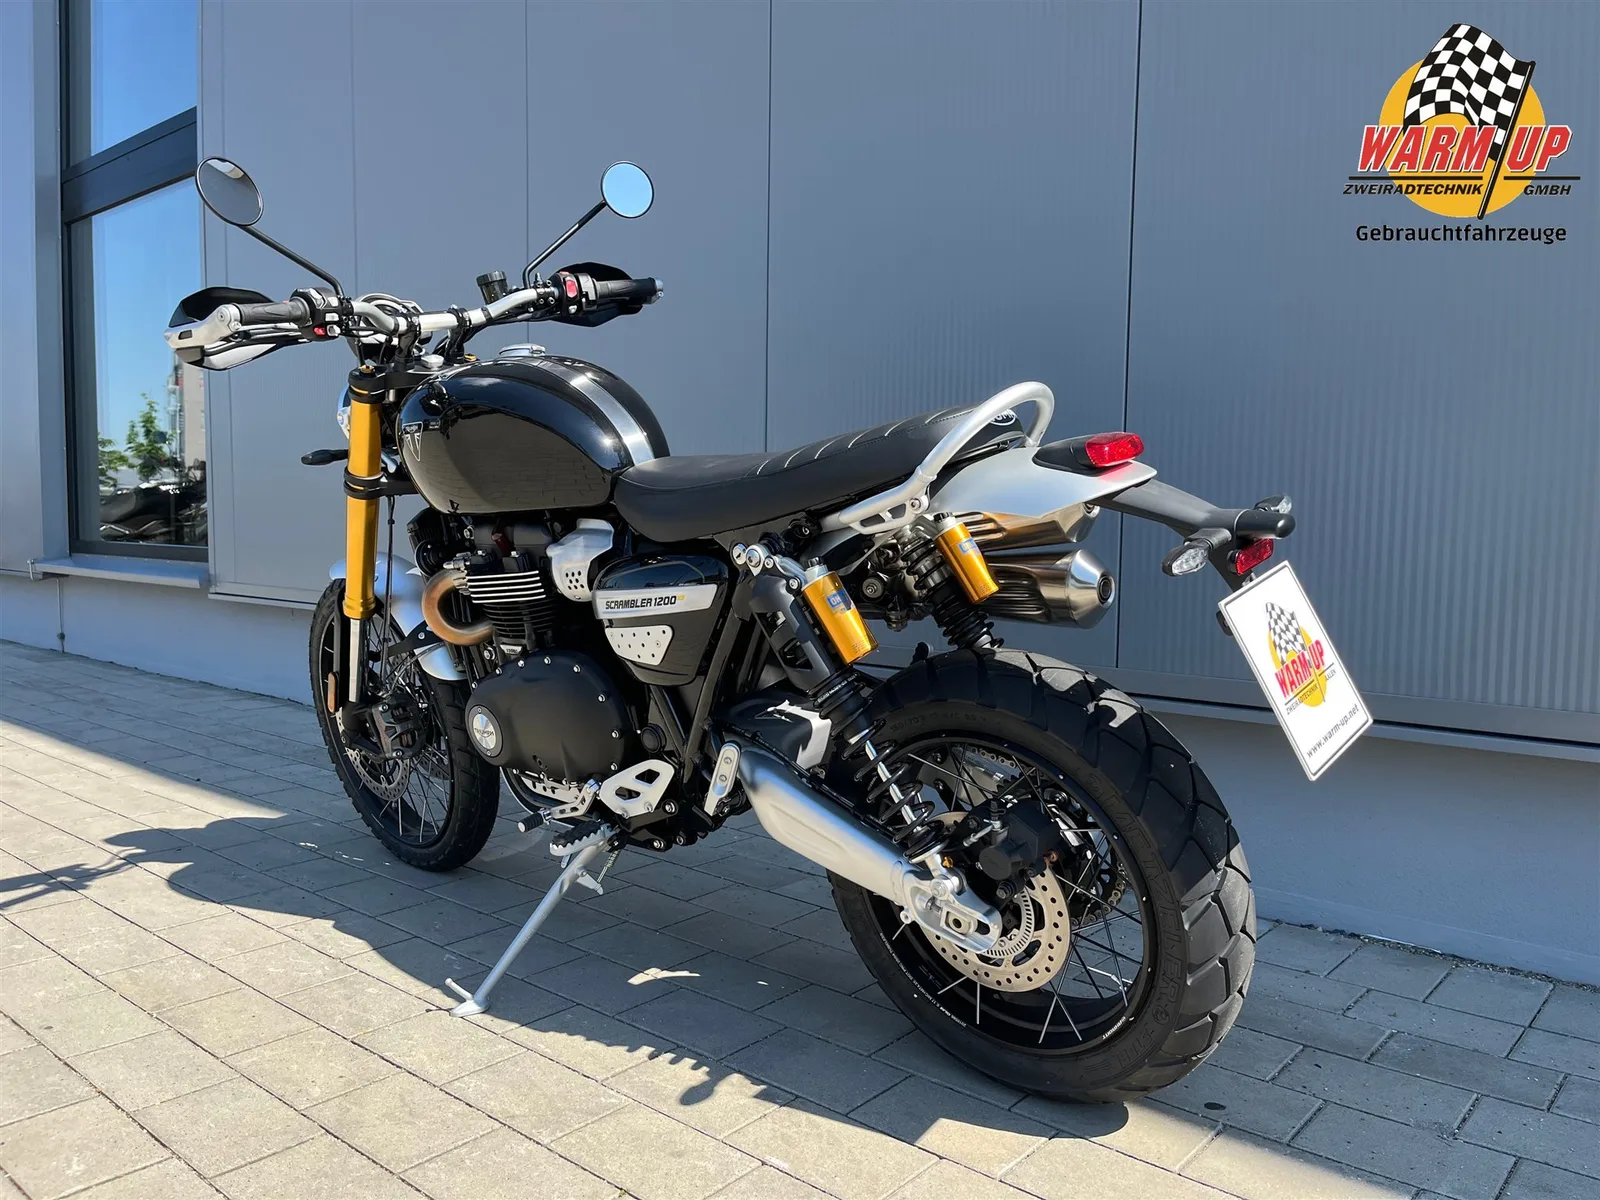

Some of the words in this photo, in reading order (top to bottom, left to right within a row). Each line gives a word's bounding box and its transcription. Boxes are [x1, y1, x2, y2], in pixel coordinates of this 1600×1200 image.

[605, 597, 653, 610] SCRAMBLER
[653, 595, 677, 607] 1200
[1275, 652, 1313, 699] WARM
[1308, 640, 1325, 671] UP
[1306, 703, 1360, 758] www.warm-up.net
